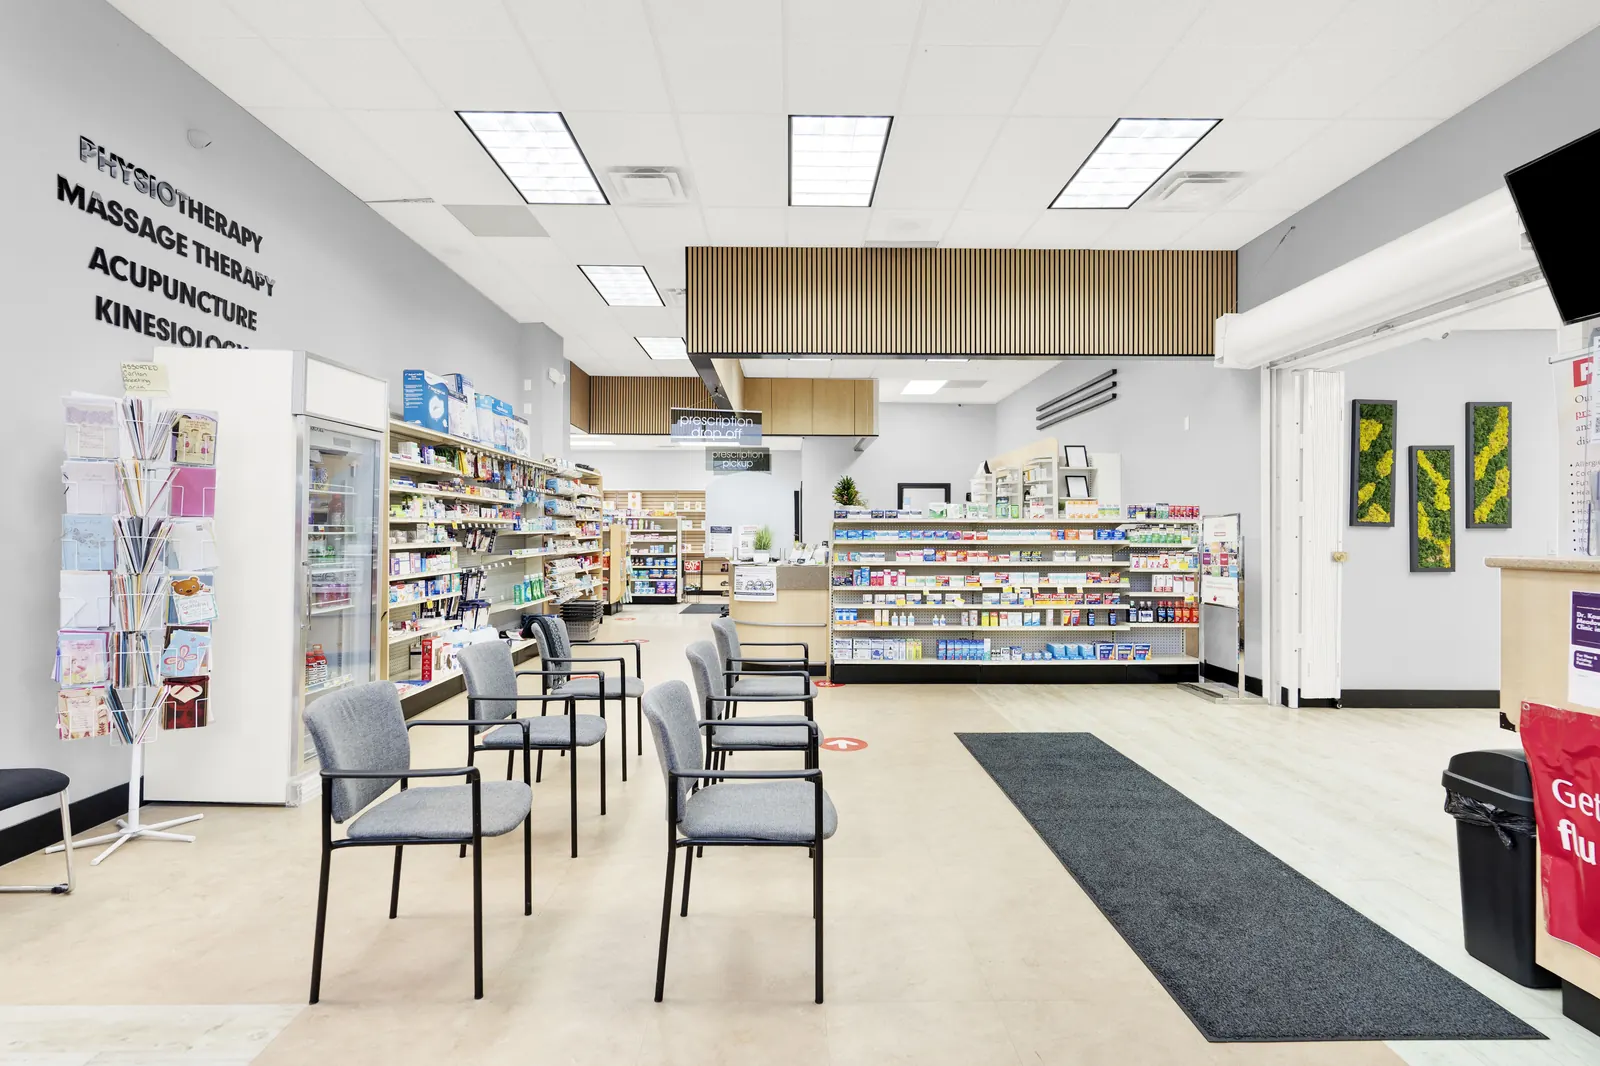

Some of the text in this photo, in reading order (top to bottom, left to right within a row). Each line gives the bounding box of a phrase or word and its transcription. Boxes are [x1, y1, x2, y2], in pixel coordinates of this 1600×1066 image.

[79, 135, 263, 253] PHYSIOTHERAPY
[57, 174, 275, 296] MASSAGE THERAPY
[88, 246, 257, 331] ACUPUNCTURE
[95, 295, 249, 349] KINESIOLO
[680, 415, 754, 428] prescription
[691, 428, 743, 441] drop off
[712, 450, 764, 459] prescription
[722, 459, 754, 469] pickup
[1551, 778, 1600, 822] Get
[1557, 818, 1597, 866] flu
